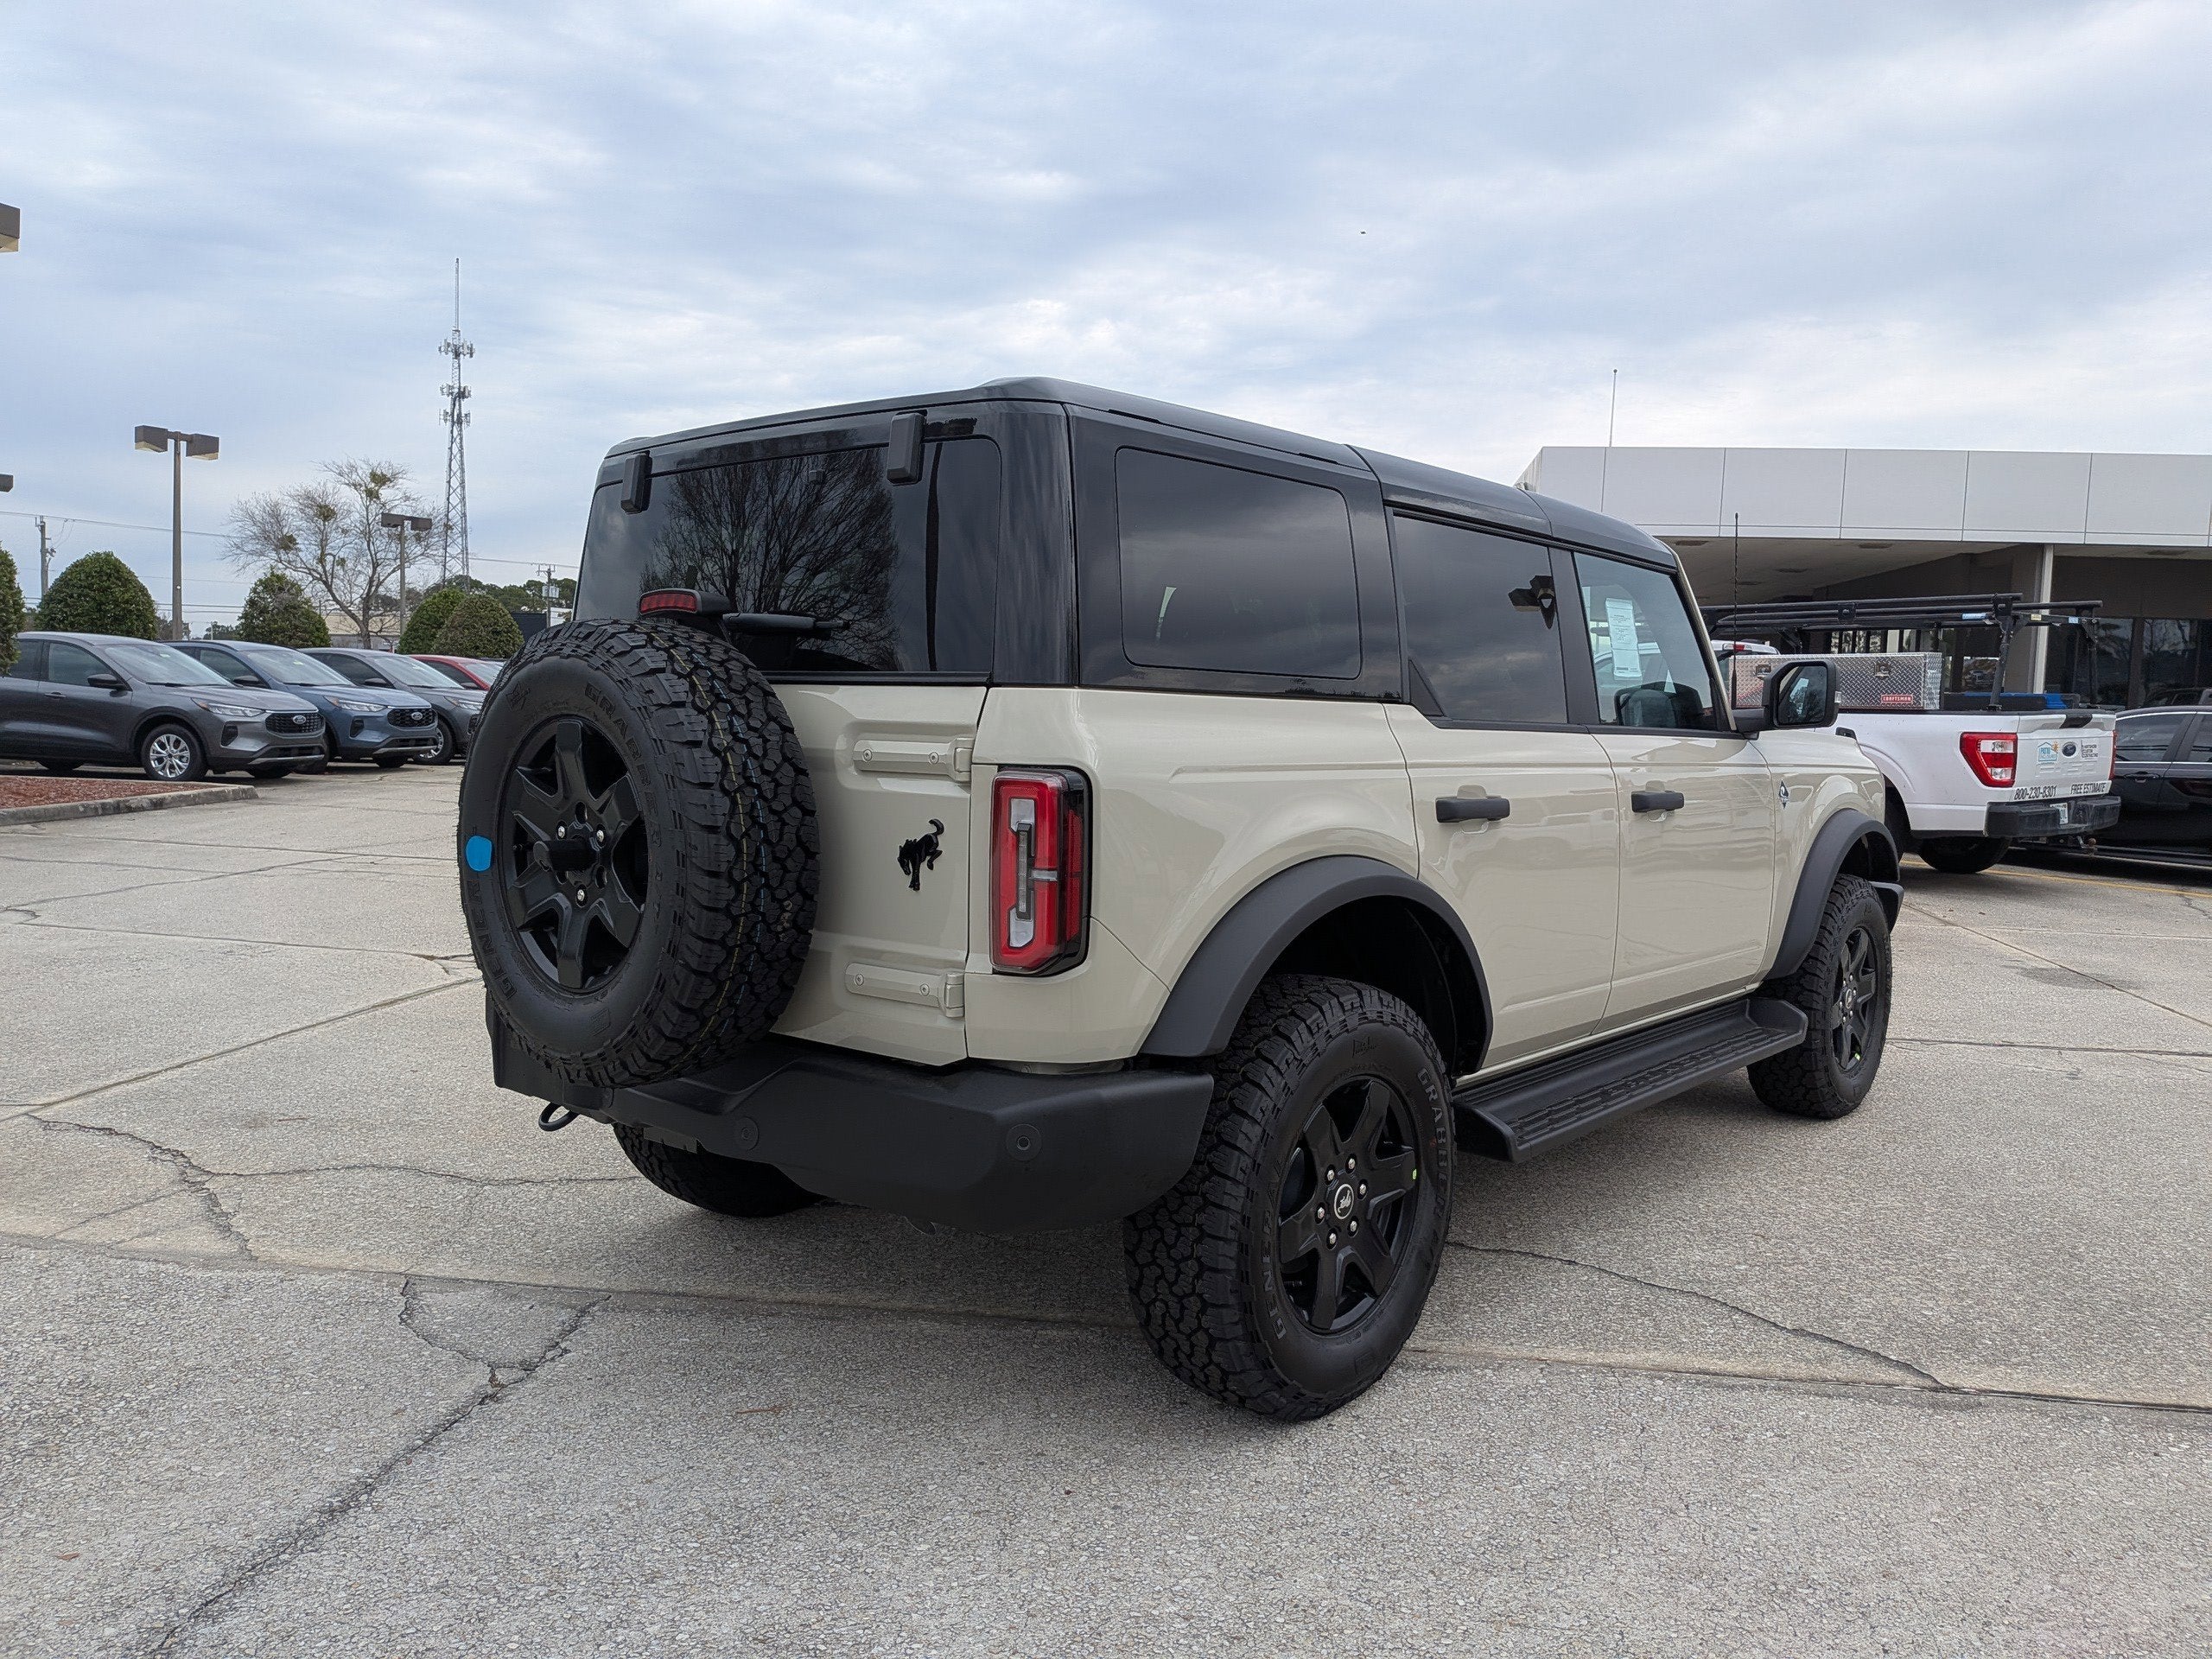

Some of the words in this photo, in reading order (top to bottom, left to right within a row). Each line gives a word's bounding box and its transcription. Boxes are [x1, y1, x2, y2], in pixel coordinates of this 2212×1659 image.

[2014, 785, 2056, 800] 800-230-8301
[2070, 784, 2082, 794] FREE
[2083, 782, 2107, 793] ESTIMATE
